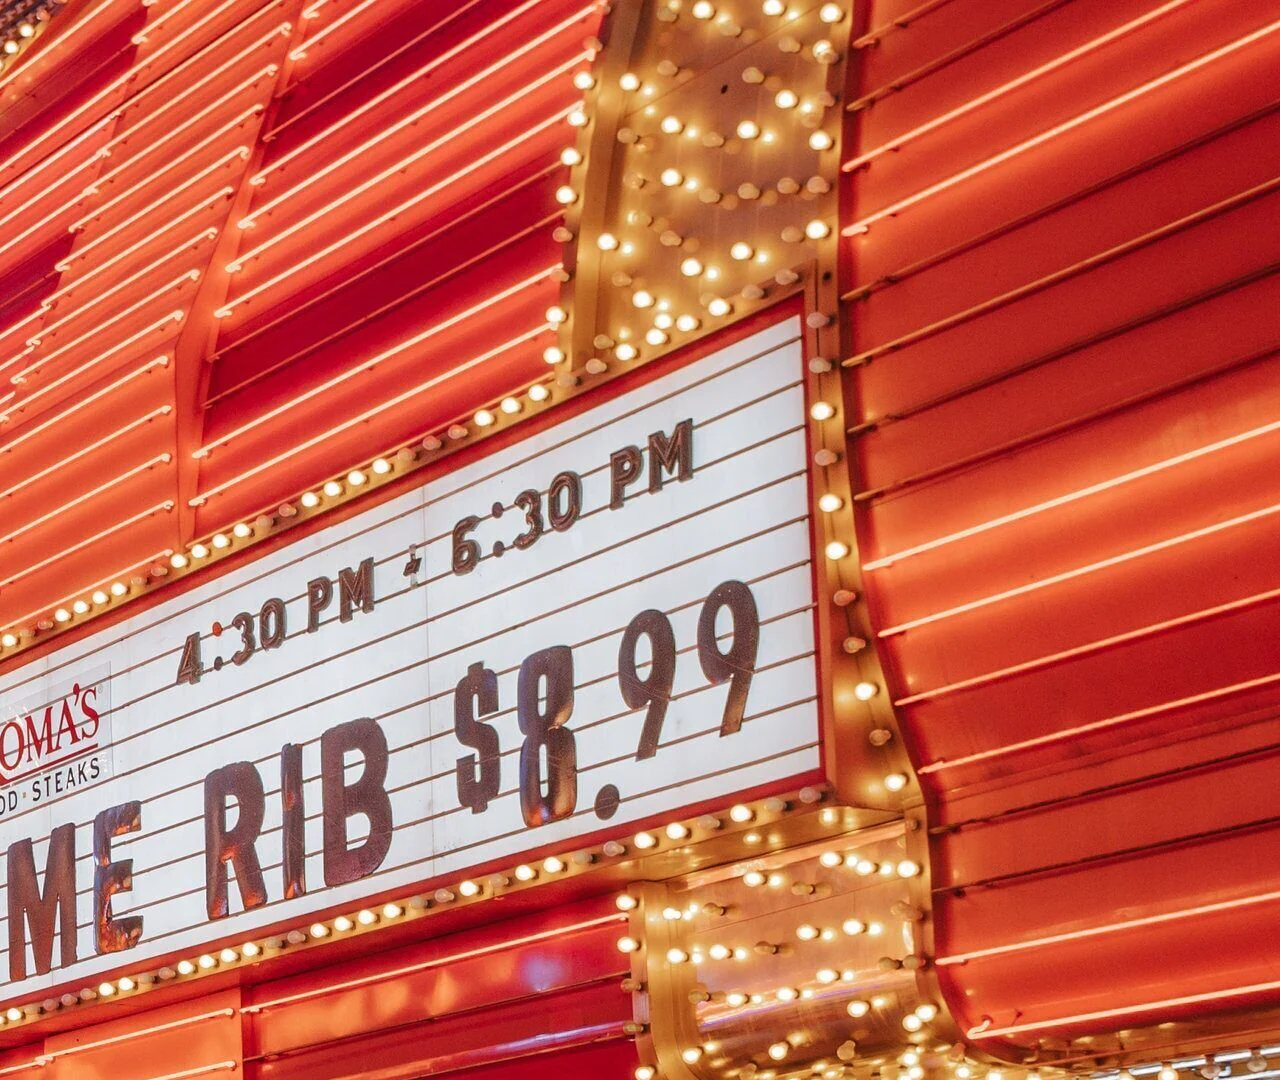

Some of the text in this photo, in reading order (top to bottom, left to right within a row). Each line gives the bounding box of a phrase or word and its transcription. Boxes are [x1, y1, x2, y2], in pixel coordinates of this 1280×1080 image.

[176, 597, 285, 685] 4:30
[308, 557, 375, 633] PM
[452, 470, 582, 576] 6:30
[610, 418, 694, 509] PM
[32, 757, 100, 802] STEAKS
[204, 717, 393, 921] RIB
[454, 580, 760, 828] $8.99
